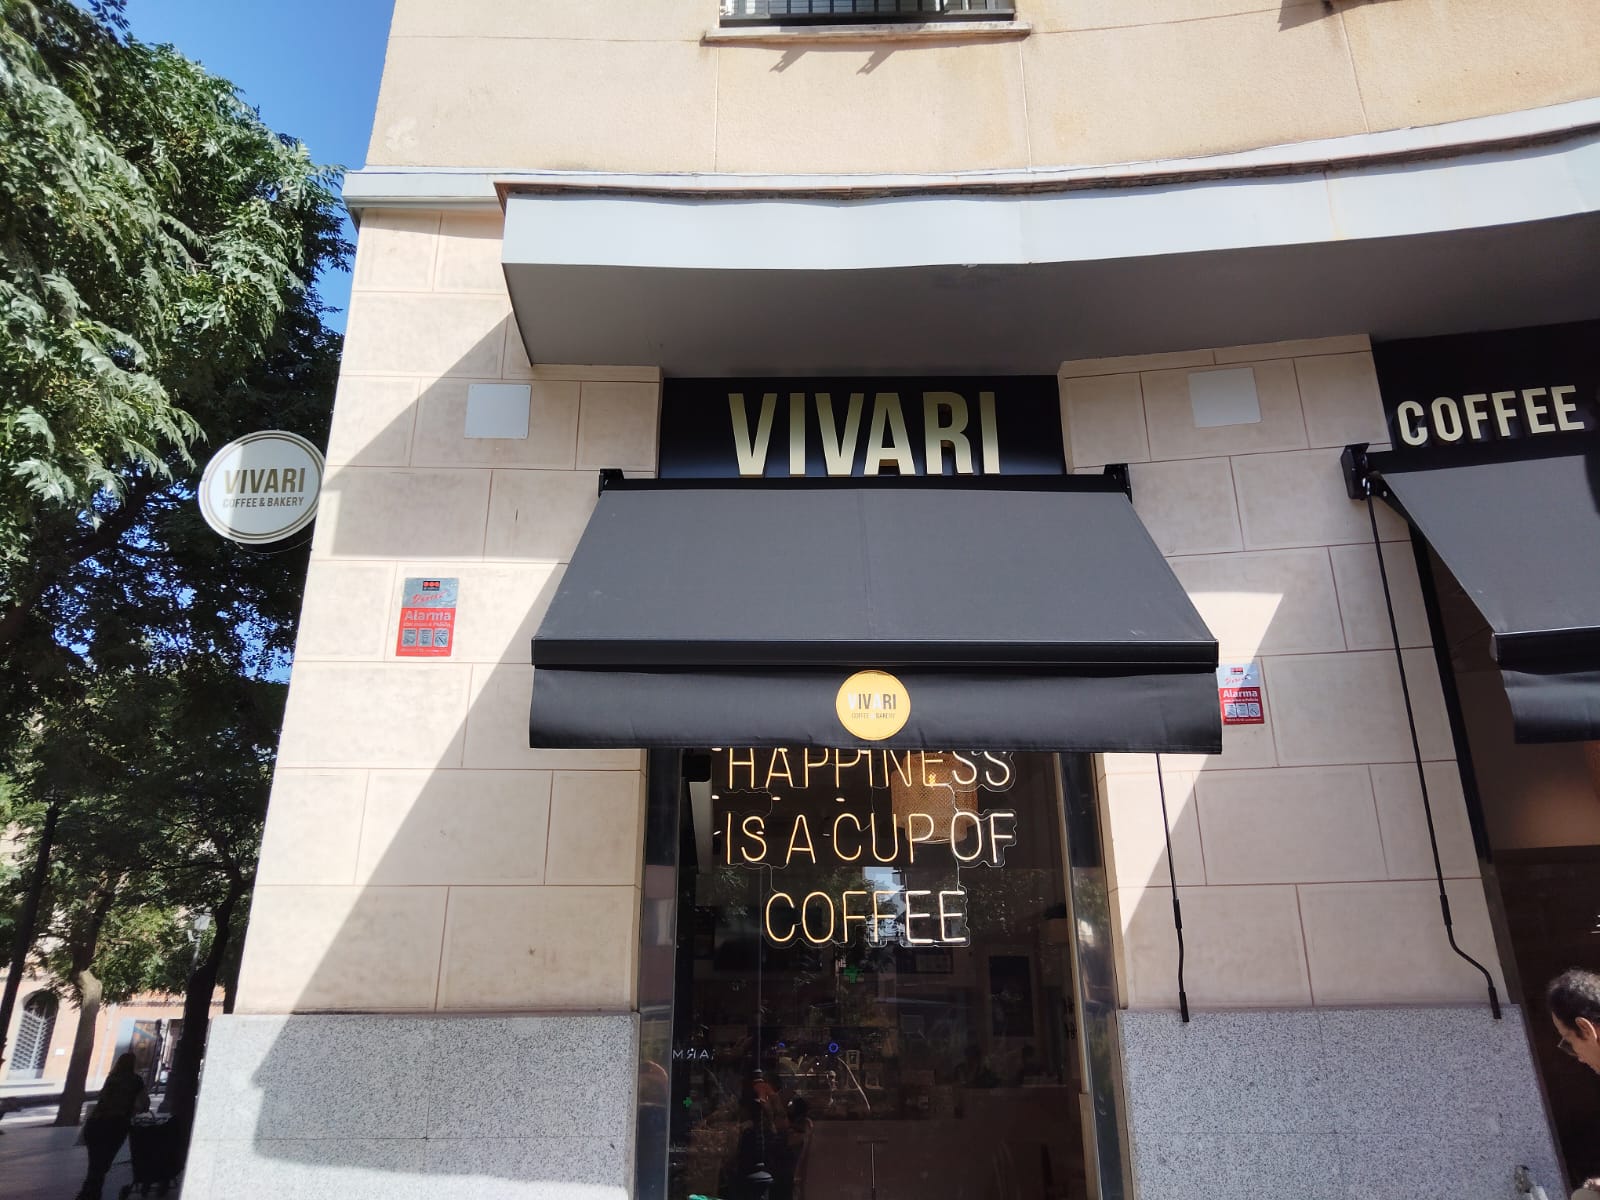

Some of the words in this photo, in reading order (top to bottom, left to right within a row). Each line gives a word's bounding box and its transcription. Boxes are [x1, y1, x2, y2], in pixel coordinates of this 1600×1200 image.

[1397, 385, 1585, 446] COFFEE
[728, 391, 1000, 476] VIVARI
[224, 468, 305, 494] VIVARI
[222, 497, 257, 508] COFFEE
[259, 497, 266, 507] &
[267, 496, 304, 507] BAKERY
[404, 610, 451, 621] Alarma
[848, 692, 897, 710] VIVARI
[1223, 689, 1258, 698] Alarma
[728, 747, 1011, 788] HAPPINESS
[727, 812, 767, 865] IS
[786, 814, 816, 865] A
[833, 812, 935, 864] CUP
[951, 811, 1015, 864] OF
[765, 890, 966, 943] COFFEE
